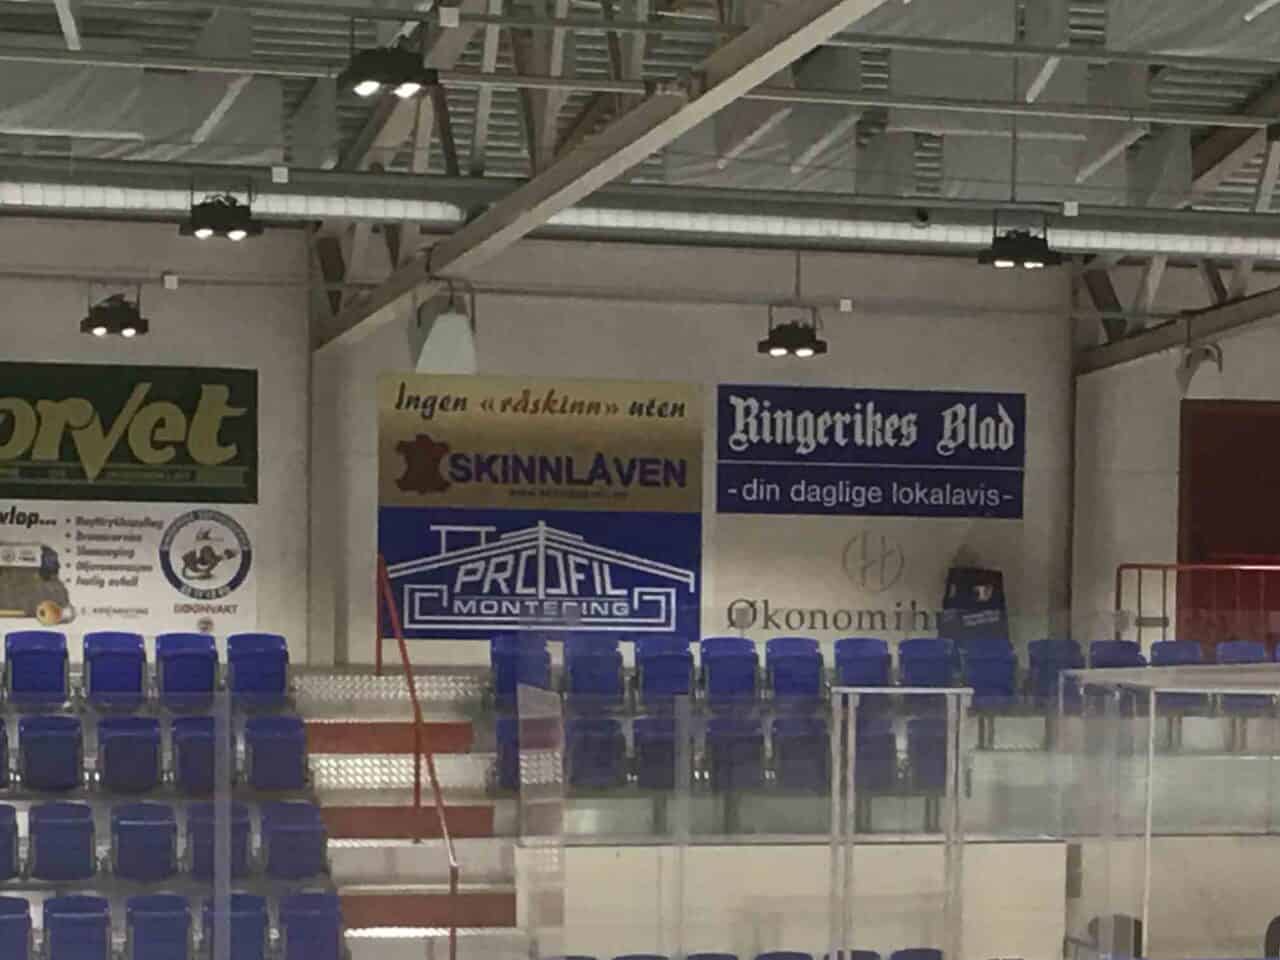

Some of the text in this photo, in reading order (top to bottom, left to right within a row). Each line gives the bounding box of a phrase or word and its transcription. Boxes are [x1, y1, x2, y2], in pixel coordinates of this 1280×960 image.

[394, 382, 468, 421] Ingen
[628, 397, 686, 418] uten
[728, 394, 1016, 456] Ringerikes Blad
[790, 479, 883, 507] daglige
[454, 549, 627, 596] PROFIL
[453, 600, 630, 616] MONTERING
